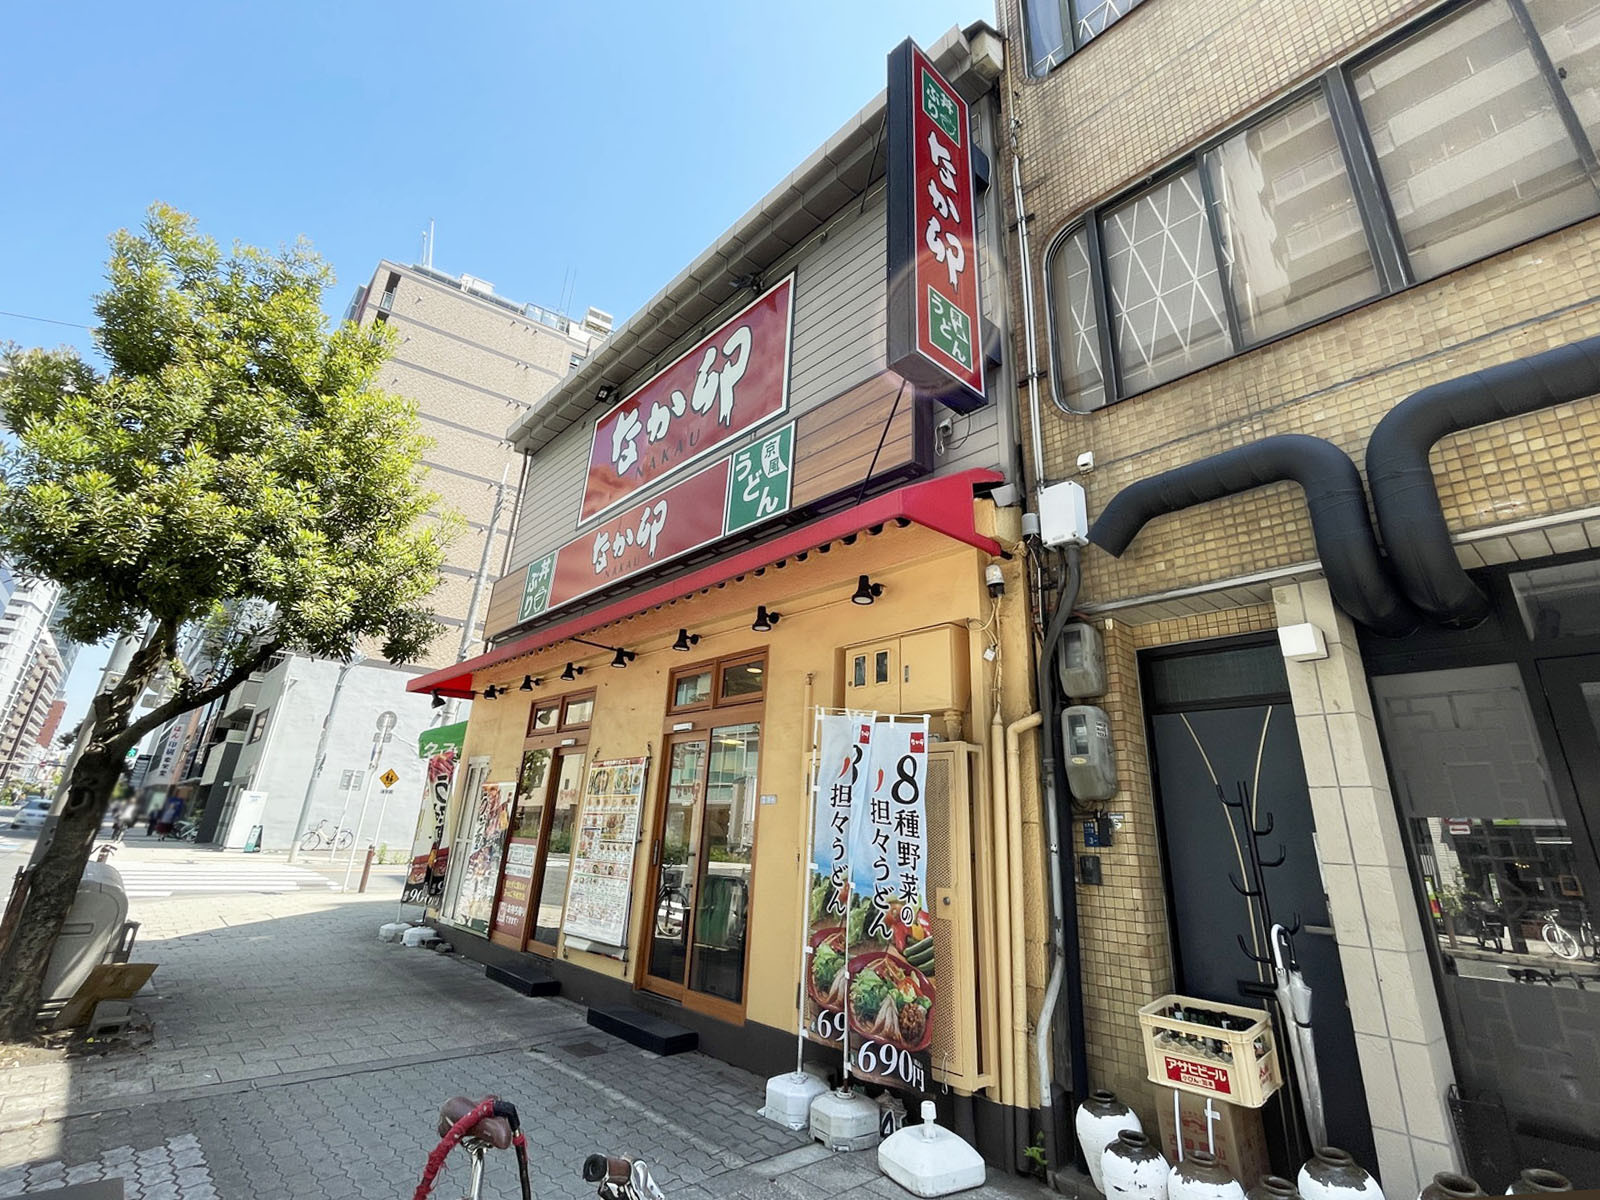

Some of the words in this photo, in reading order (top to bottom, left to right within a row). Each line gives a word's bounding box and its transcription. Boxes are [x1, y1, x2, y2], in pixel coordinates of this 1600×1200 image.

[926, 131, 966, 294] なか卯
[931, 293, 967, 363] うどん
[610, 326, 752, 477] なか卯
[635, 429, 700, 479] NAKAU
[735, 452, 779, 517] うどん
[764, 440, 780, 476] 京風
[592, 499, 668, 575] なか卯
[827, 783, 851, 915] 担々うどん
[868, 797, 894, 938] 担々うどん
[891, 754, 921, 926] 8種野菜の
[857, 1040, 925, 1093] 690円
[1166, 1058, 1227, 1082] アサヒビール
